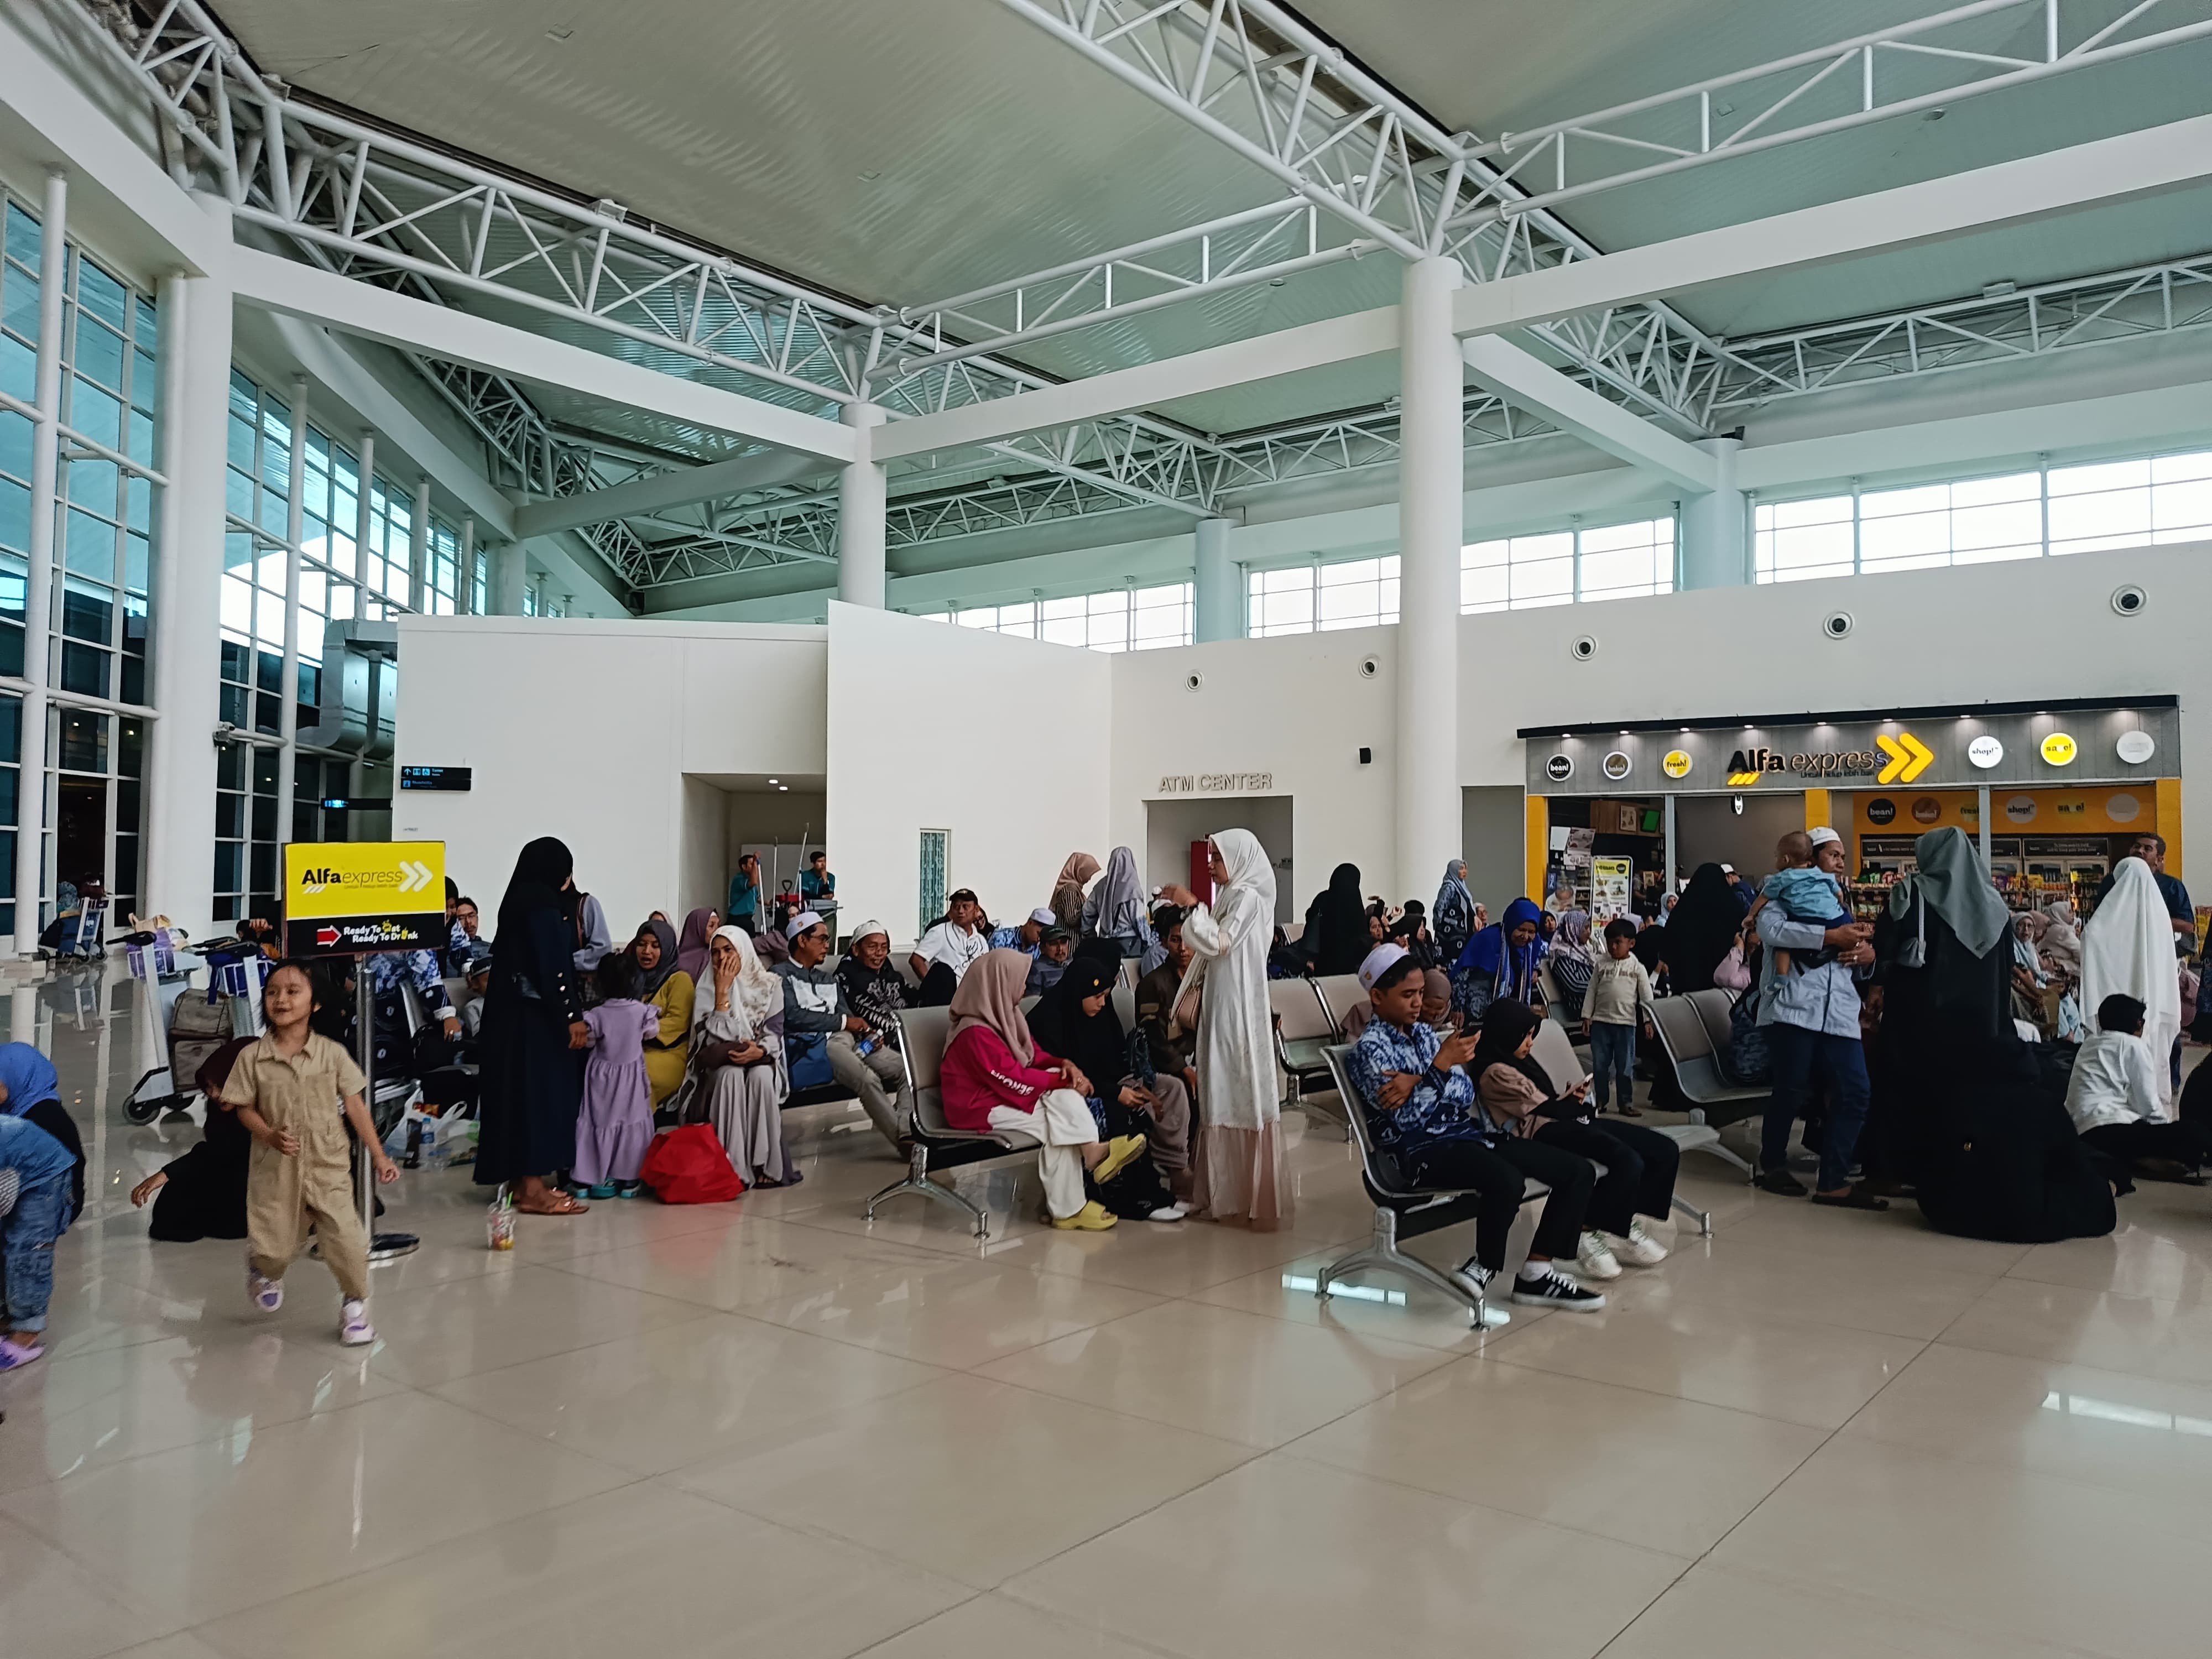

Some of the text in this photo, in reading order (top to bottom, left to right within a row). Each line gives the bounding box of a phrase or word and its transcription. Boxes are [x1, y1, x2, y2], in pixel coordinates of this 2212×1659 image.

[2046, 743, 2071, 752] sae!
[1550, 763, 1568, 771] bean!
[1159, 772, 1272, 793] ATM CENTER
[2058, 802, 2084, 813] sae!
[343, 926, 371, 935] Ready
[372, 925, 381, 933] To
[352, 935, 379, 944] Ready
